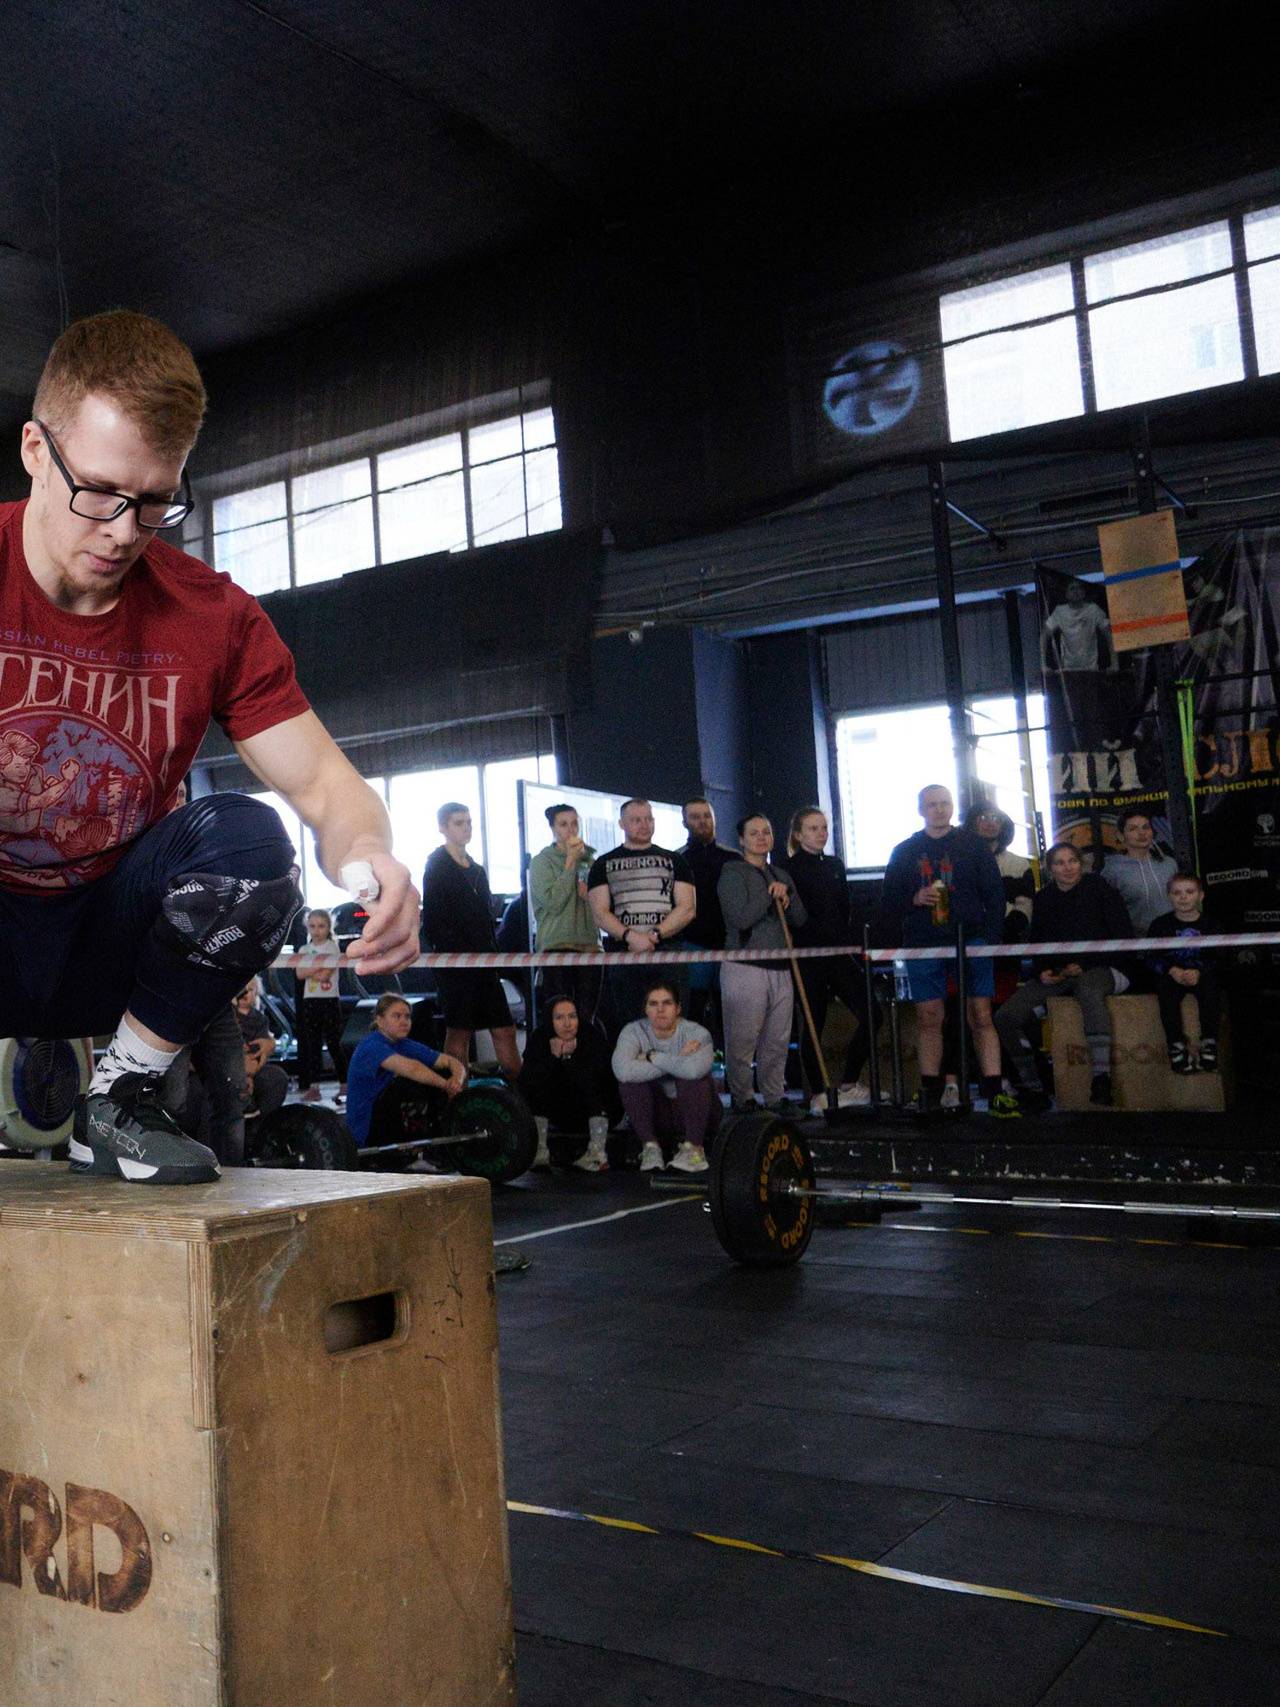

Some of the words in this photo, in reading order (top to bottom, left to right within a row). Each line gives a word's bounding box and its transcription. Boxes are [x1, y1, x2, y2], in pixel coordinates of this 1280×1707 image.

[53, 641, 110, 661] REBEL
[606, 857, 674, 873] STRENGTH
[620, 913, 658, 926] OTHING
